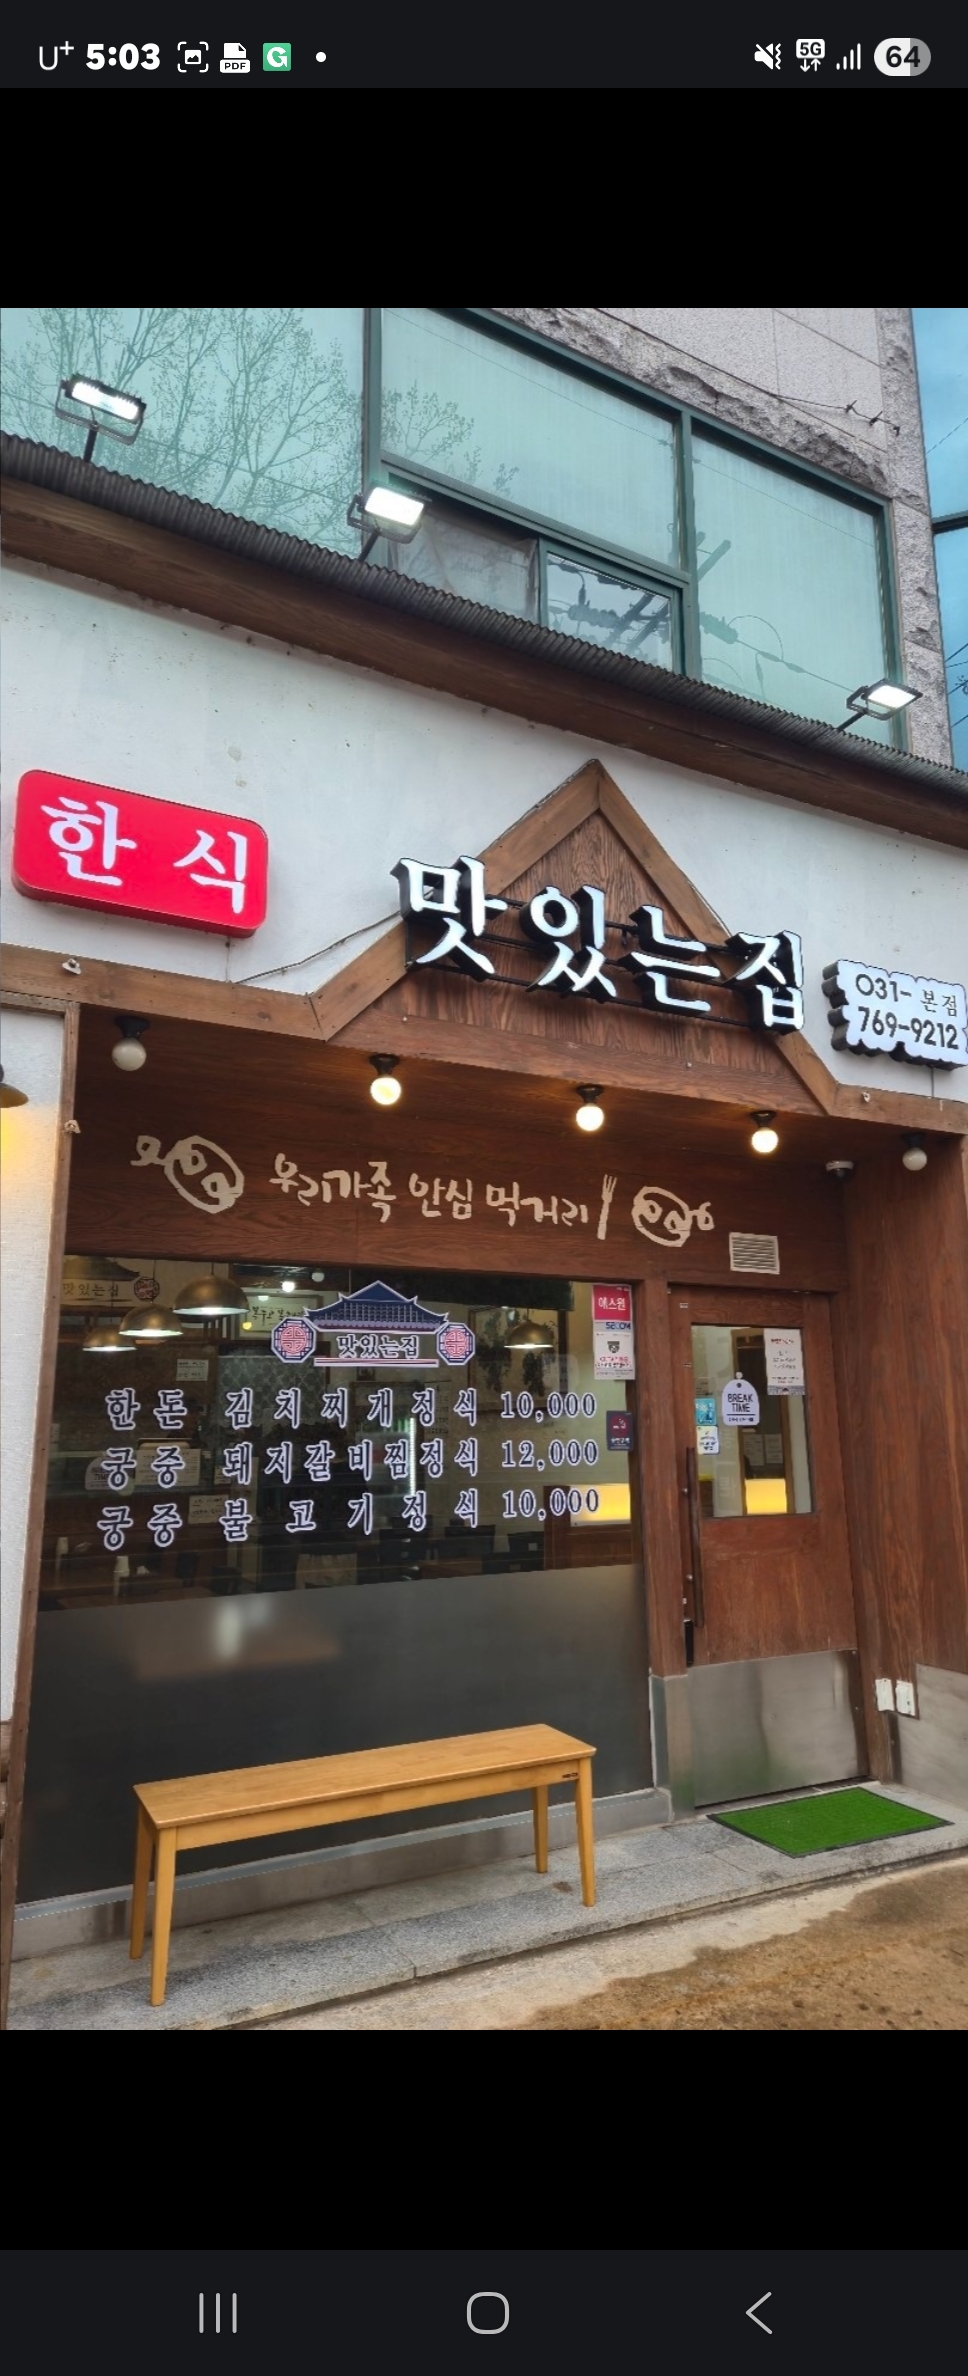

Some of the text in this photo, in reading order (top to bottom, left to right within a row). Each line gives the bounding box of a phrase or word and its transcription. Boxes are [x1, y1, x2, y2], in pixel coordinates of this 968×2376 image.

[393, 855, 806, 1034] 맛있는집
[858, 1006, 960, 1050] 769-9212
[269, 1153, 588, 1226] 우리가족 안심 먹거리
[337, 1334, 419, 1359] 맛있는집
[500, 1391, 597, 1423] 10,000
[727, 1393, 753, 1403] BREAK
[731, 1403, 751, 1412] TIME
[502, 1439, 599, 1471] 12,000
